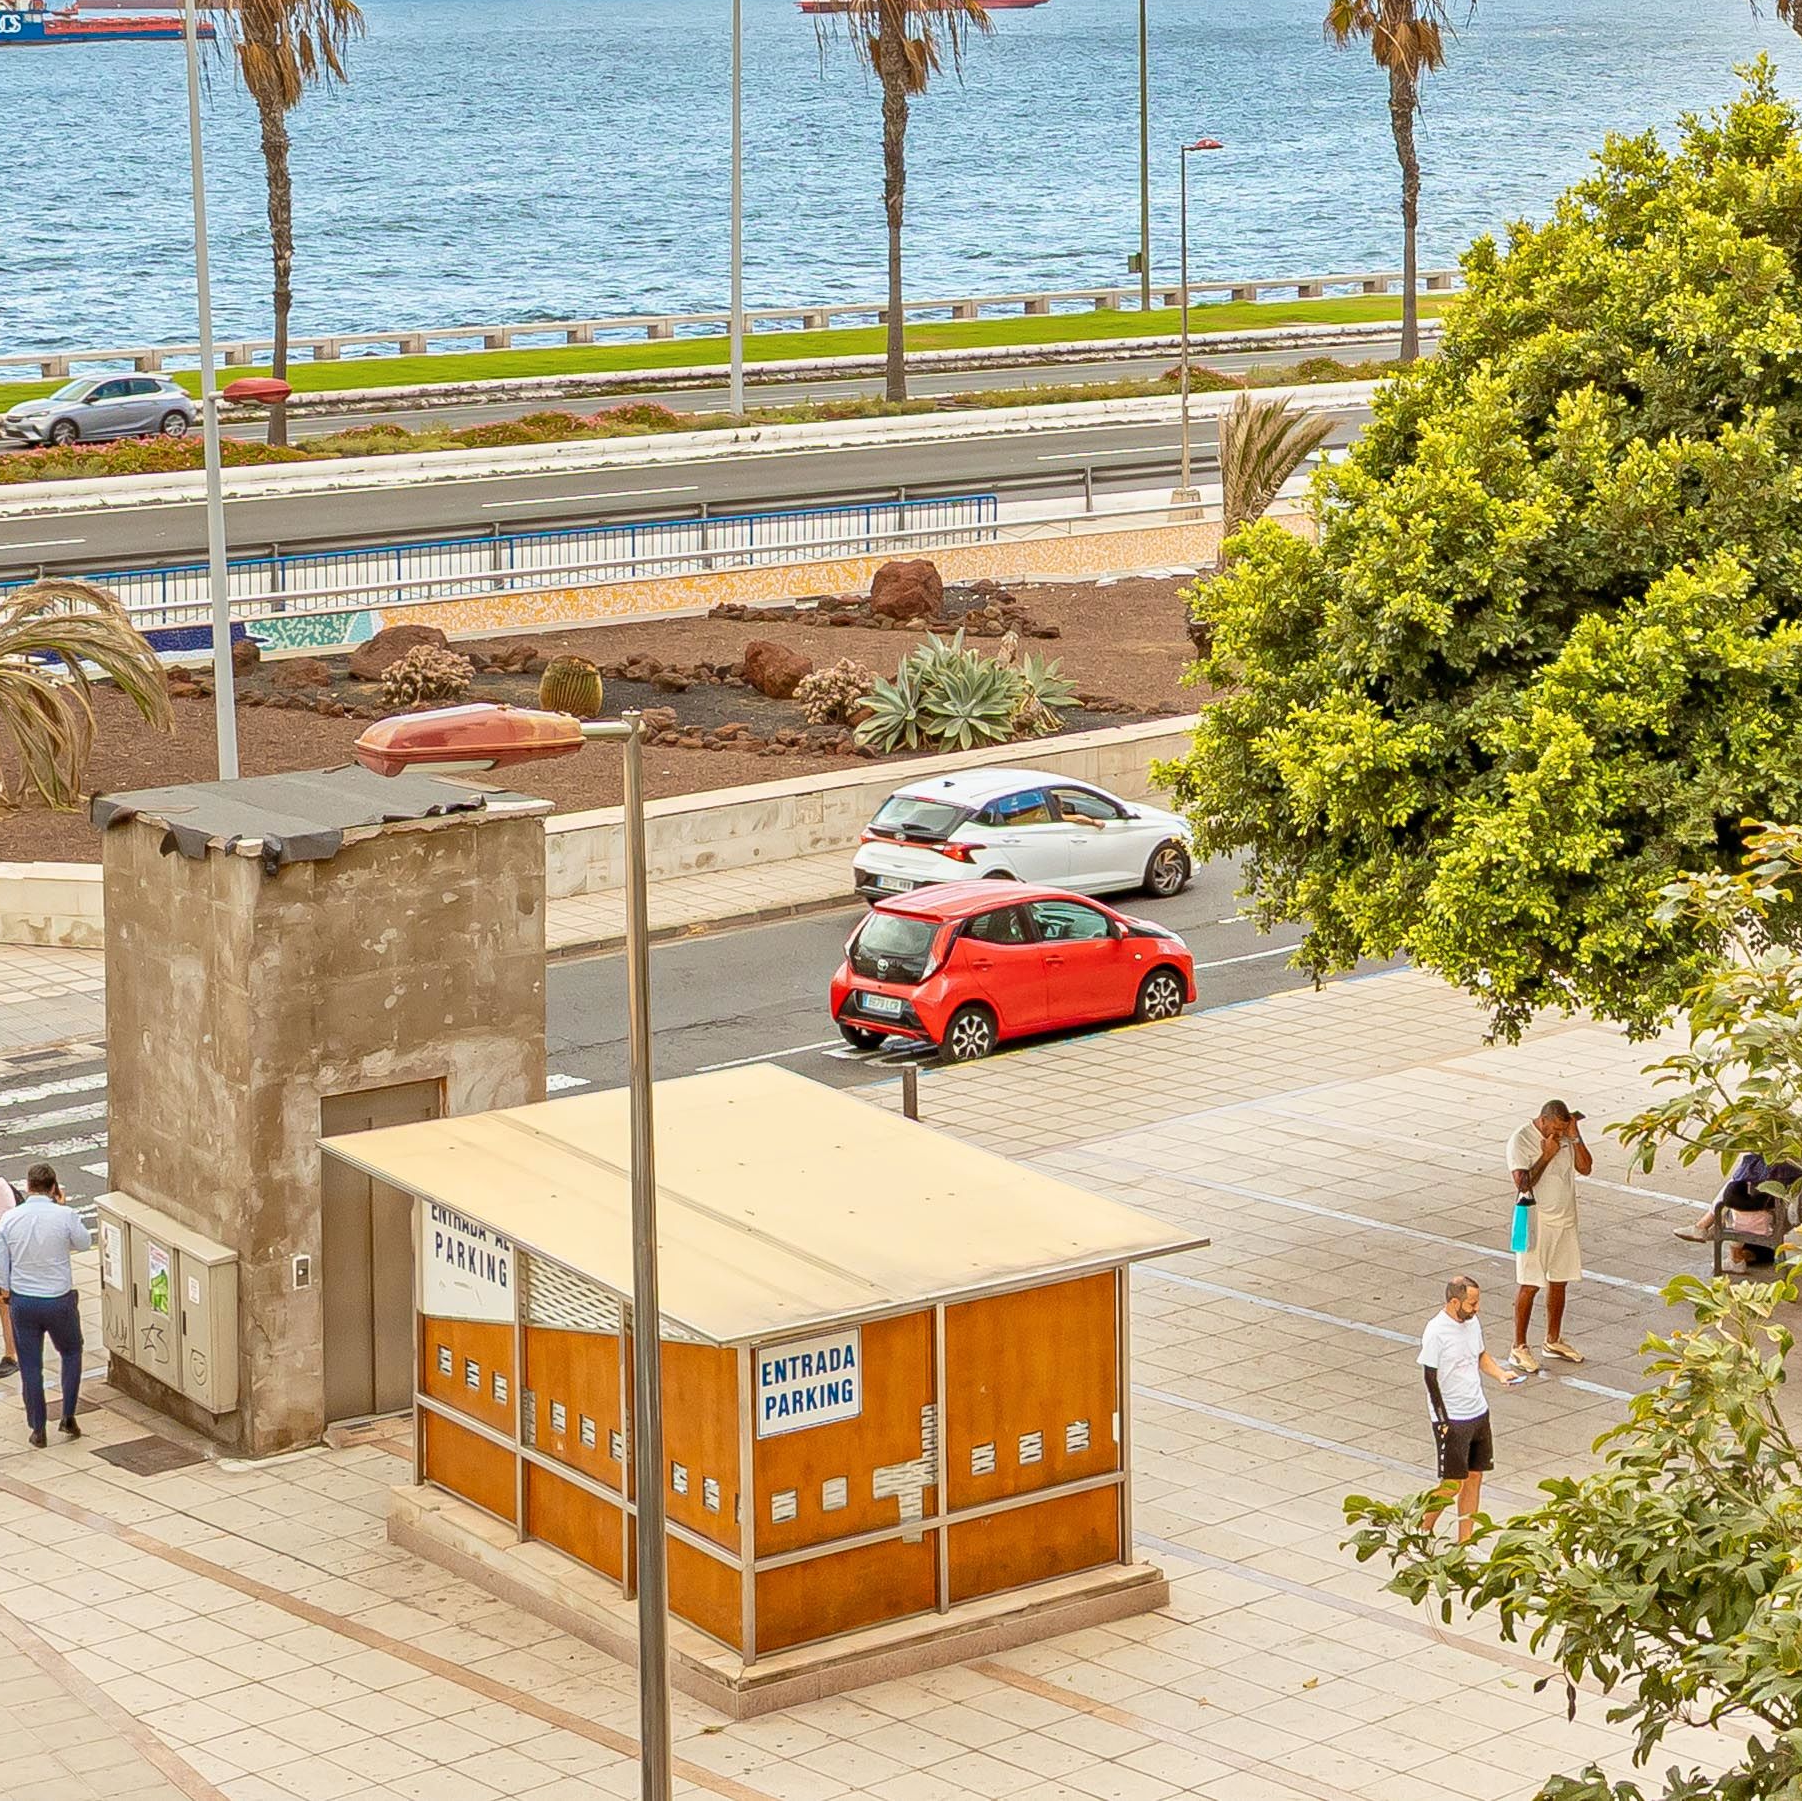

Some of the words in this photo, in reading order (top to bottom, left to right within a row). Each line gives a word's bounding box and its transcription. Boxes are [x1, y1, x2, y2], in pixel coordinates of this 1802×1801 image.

[435, 1231, 507, 1288] PARKING
[762, 1344, 855, 1387] ENTRADA
[765, 1377, 853, 1420] PARKING
